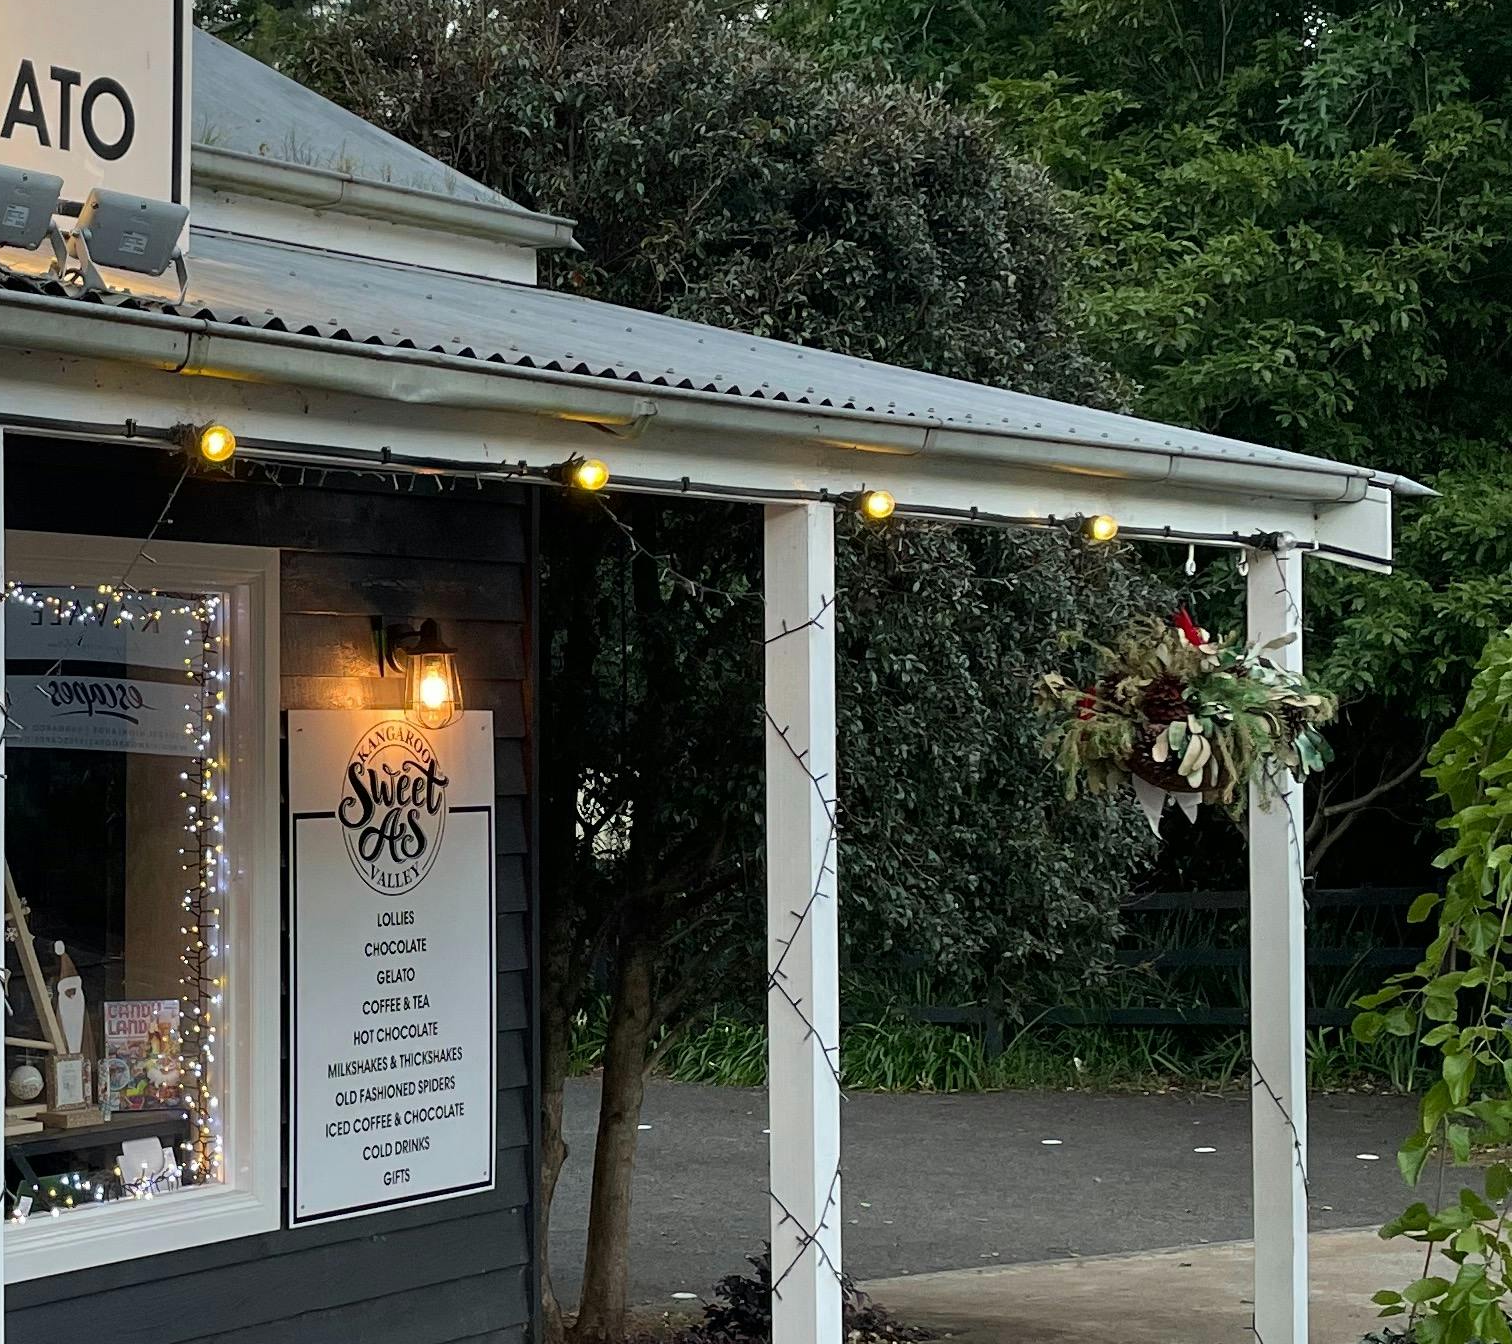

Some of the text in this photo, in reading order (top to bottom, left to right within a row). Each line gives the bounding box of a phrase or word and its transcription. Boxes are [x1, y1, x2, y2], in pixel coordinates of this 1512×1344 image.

[357, 725, 432, 763] KANGAROO
[338, 758, 449, 829] Sweet
[370, 863, 420, 888] VALLEY
[377, 911, 415, 927] LOLLIES
[364, 937, 427, 957] CHOCOLATE
[376, 967, 415, 984] GELATO
[362, 994, 430, 1015] COFFEE & TEA
[108, 1019, 148, 1035] LAND
[353, 1021, 438, 1045] HOT CHOCOLATE
[327, 1046, 463, 1078] MILKSHAKES & THICKSHAKES
[335, 1075, 456, 1106] OLD FASHIONED SPIDERS
[325, 1102, 465, 1138] ICED COFFEE & CHOCOLATE
[362, 1136, 430, 1161] COLD DRINKS
[383, 1168, 411, 1186] GIFTS
